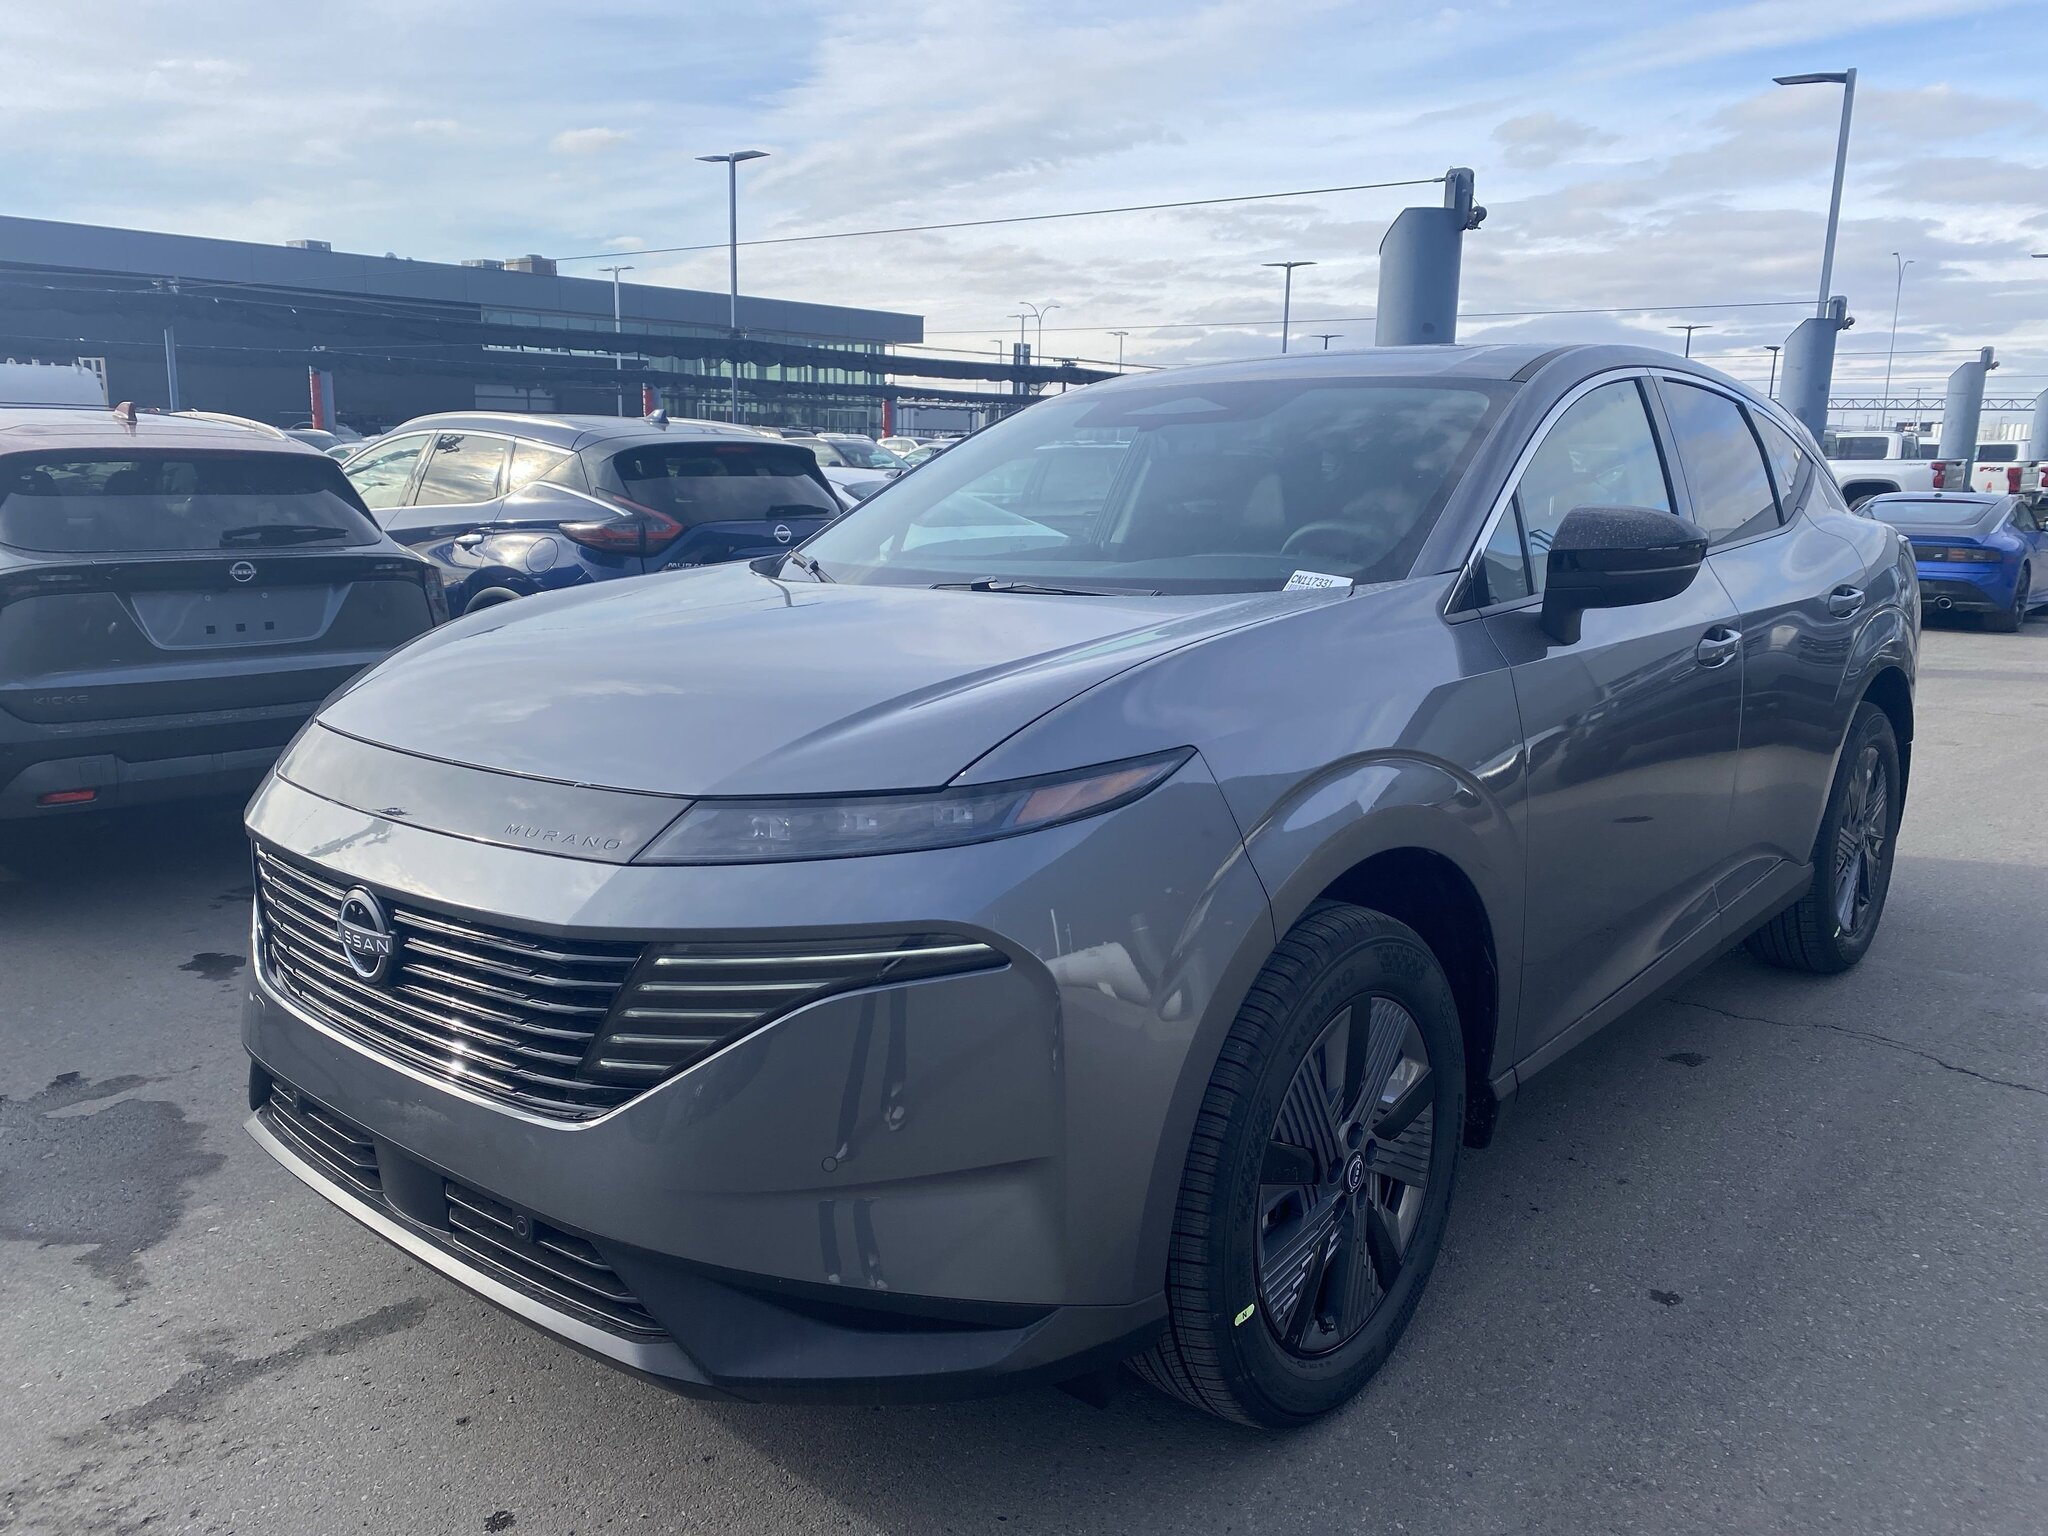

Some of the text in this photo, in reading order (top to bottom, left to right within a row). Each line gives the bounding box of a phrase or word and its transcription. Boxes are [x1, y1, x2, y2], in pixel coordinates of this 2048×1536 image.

[1290, 574, 1334, 588] CN117331
[32, 694, 89, 705] KICKS
[503, 823, 623, 850] MURANO
[343, 929, 390, 954] SSAN
[1286, 967, 1356, 1058] KUMHO
